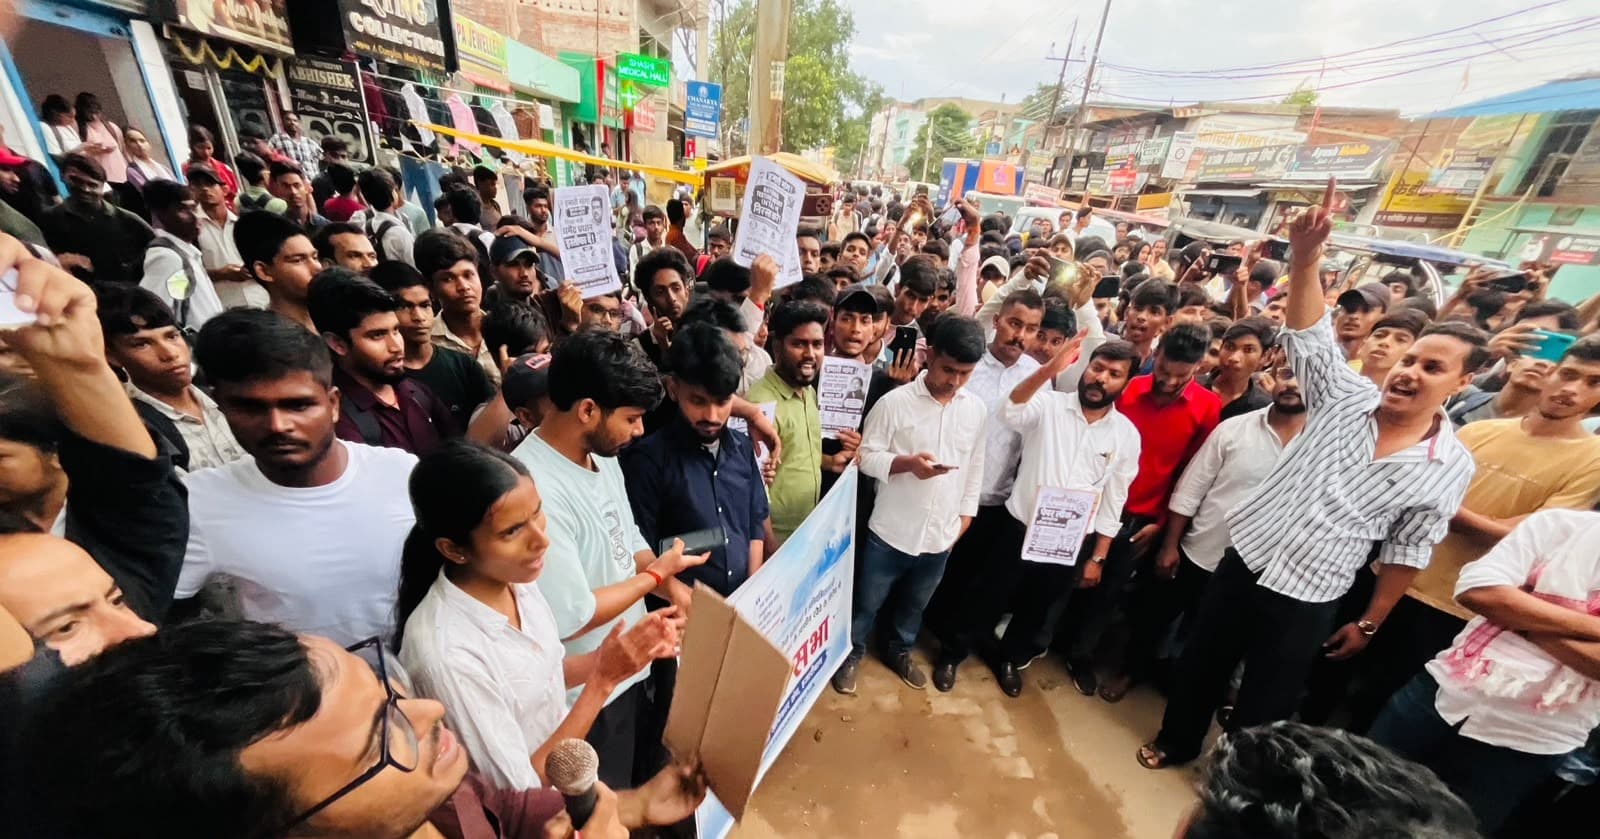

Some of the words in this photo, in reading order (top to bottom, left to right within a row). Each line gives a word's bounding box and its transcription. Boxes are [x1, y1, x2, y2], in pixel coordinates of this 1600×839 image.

[349, 11, 446, 57] COLLECTION
[618, 66, 648, 78] MEDICAL
[649, 72, 667, 82] HALL
[629, 58, 655, 70] SHASHI
[289, 66, 356, 89] ABHISHEK
[793, 614, 829, 677] सभा
